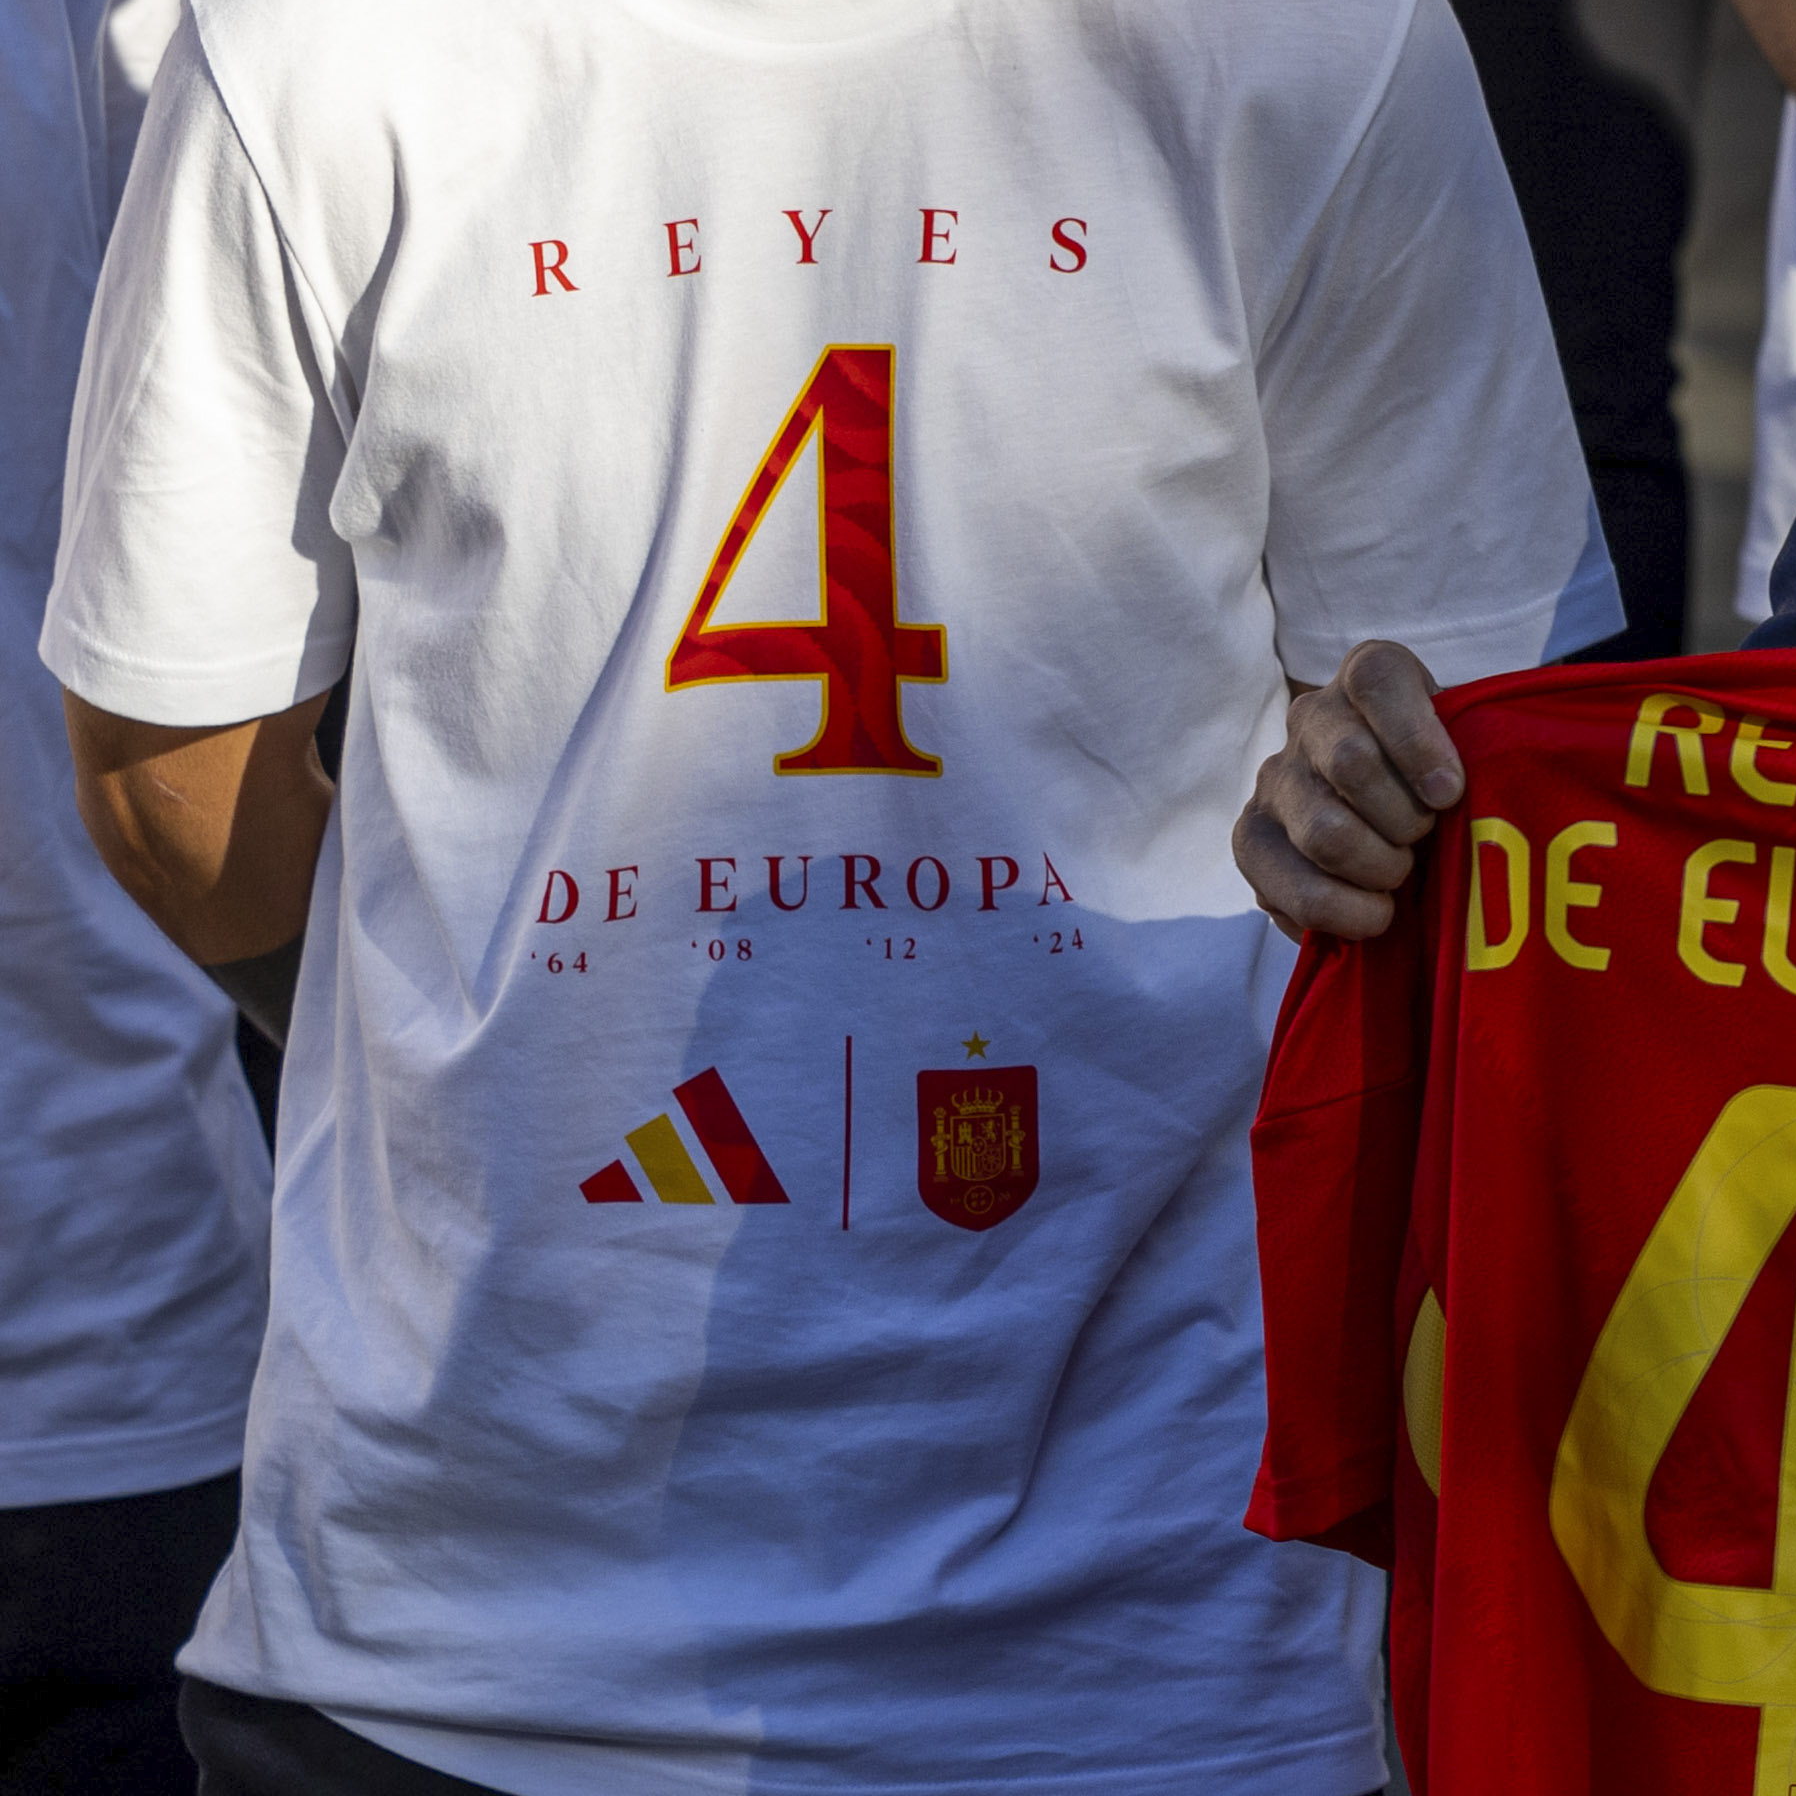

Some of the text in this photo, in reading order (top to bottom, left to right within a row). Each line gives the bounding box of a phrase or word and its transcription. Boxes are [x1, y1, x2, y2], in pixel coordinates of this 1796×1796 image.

[527, 207, 1089, 297] REYES
[664, 343, 949, 778] 4
[536, 851, 1074, 924] DE EUROPA
[1466, 816, 1618, 972] DE
